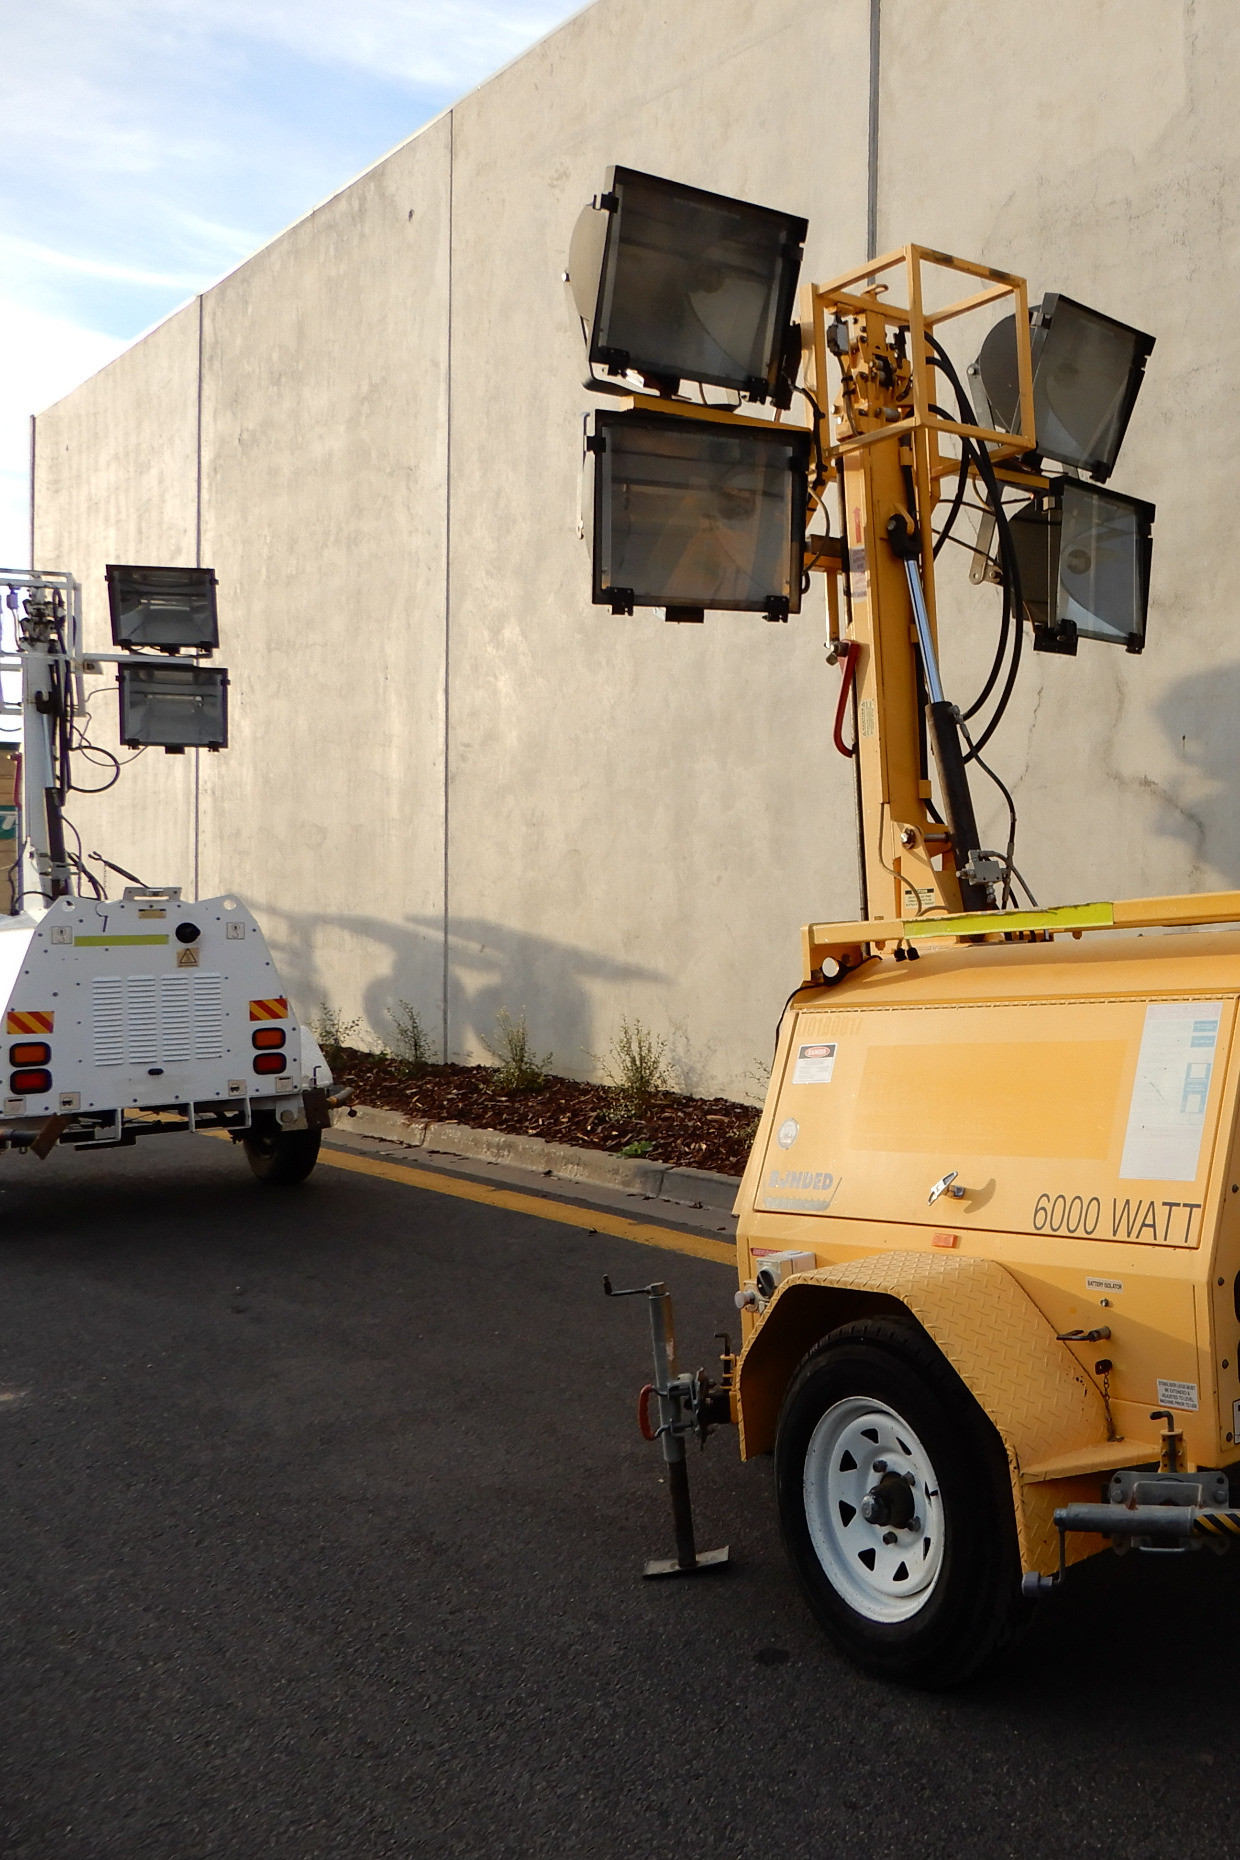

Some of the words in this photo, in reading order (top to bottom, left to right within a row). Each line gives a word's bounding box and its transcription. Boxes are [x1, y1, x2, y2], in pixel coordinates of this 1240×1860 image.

[807, 1048, 827, 1056] DANGER
[1033, 1193, 1100, 1235] 6000
[1112, 1198, 1202, 1243] WATT
[1087, 1280, 1103, 1288] BATTERY
[1104, 1282, 1122, 1290] ISOLATOR
